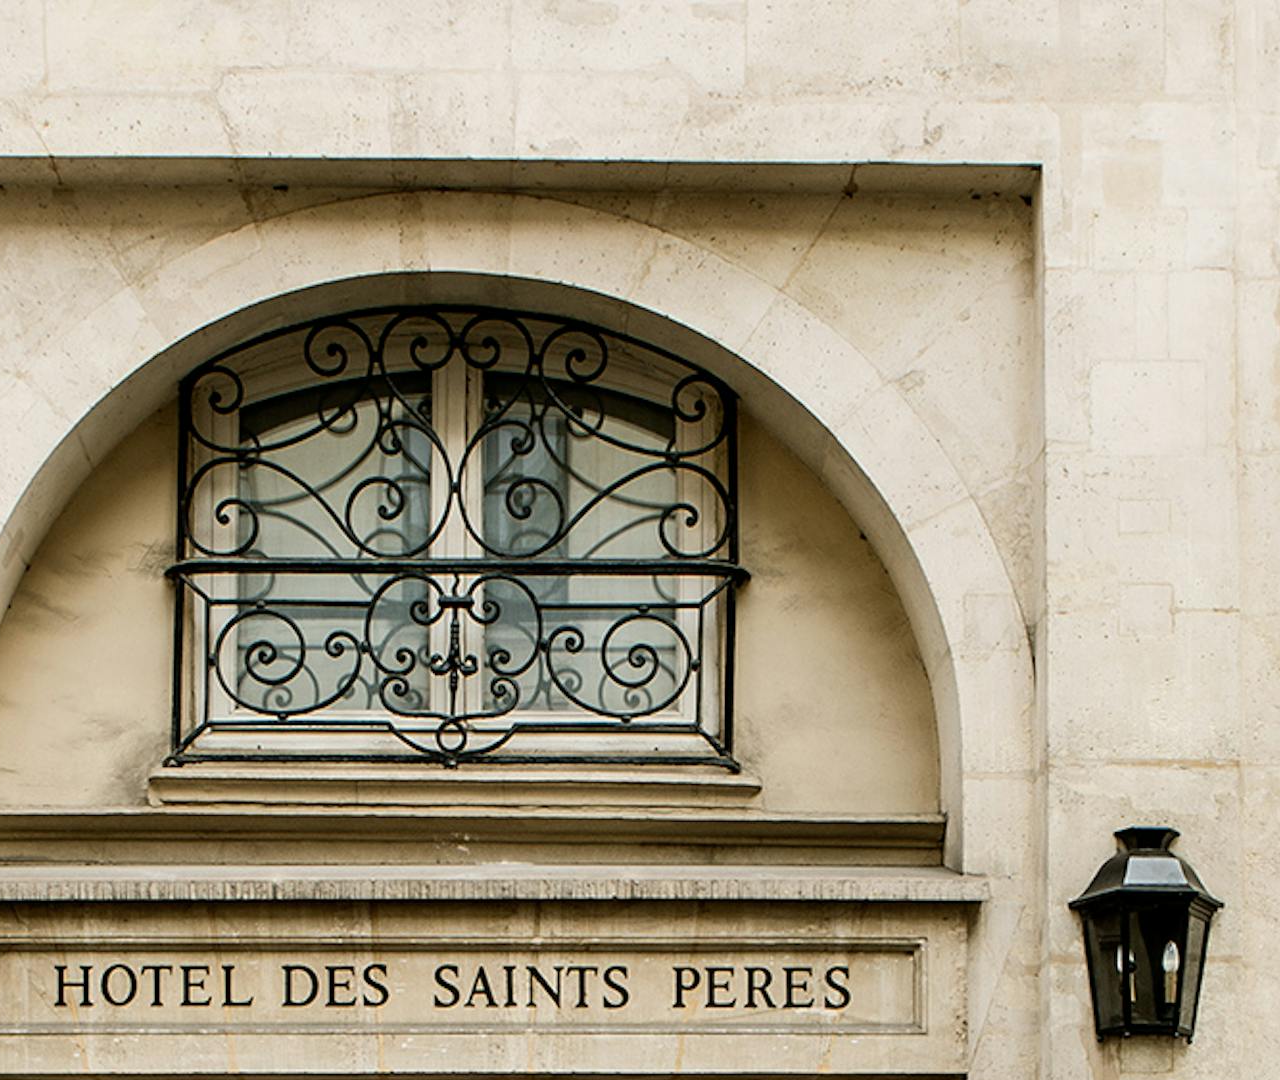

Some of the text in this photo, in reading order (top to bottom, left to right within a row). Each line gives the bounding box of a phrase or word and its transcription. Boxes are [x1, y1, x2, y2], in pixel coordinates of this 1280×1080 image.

[54, 963, 851, 1010] HOTEL DES SAINTS PERES
